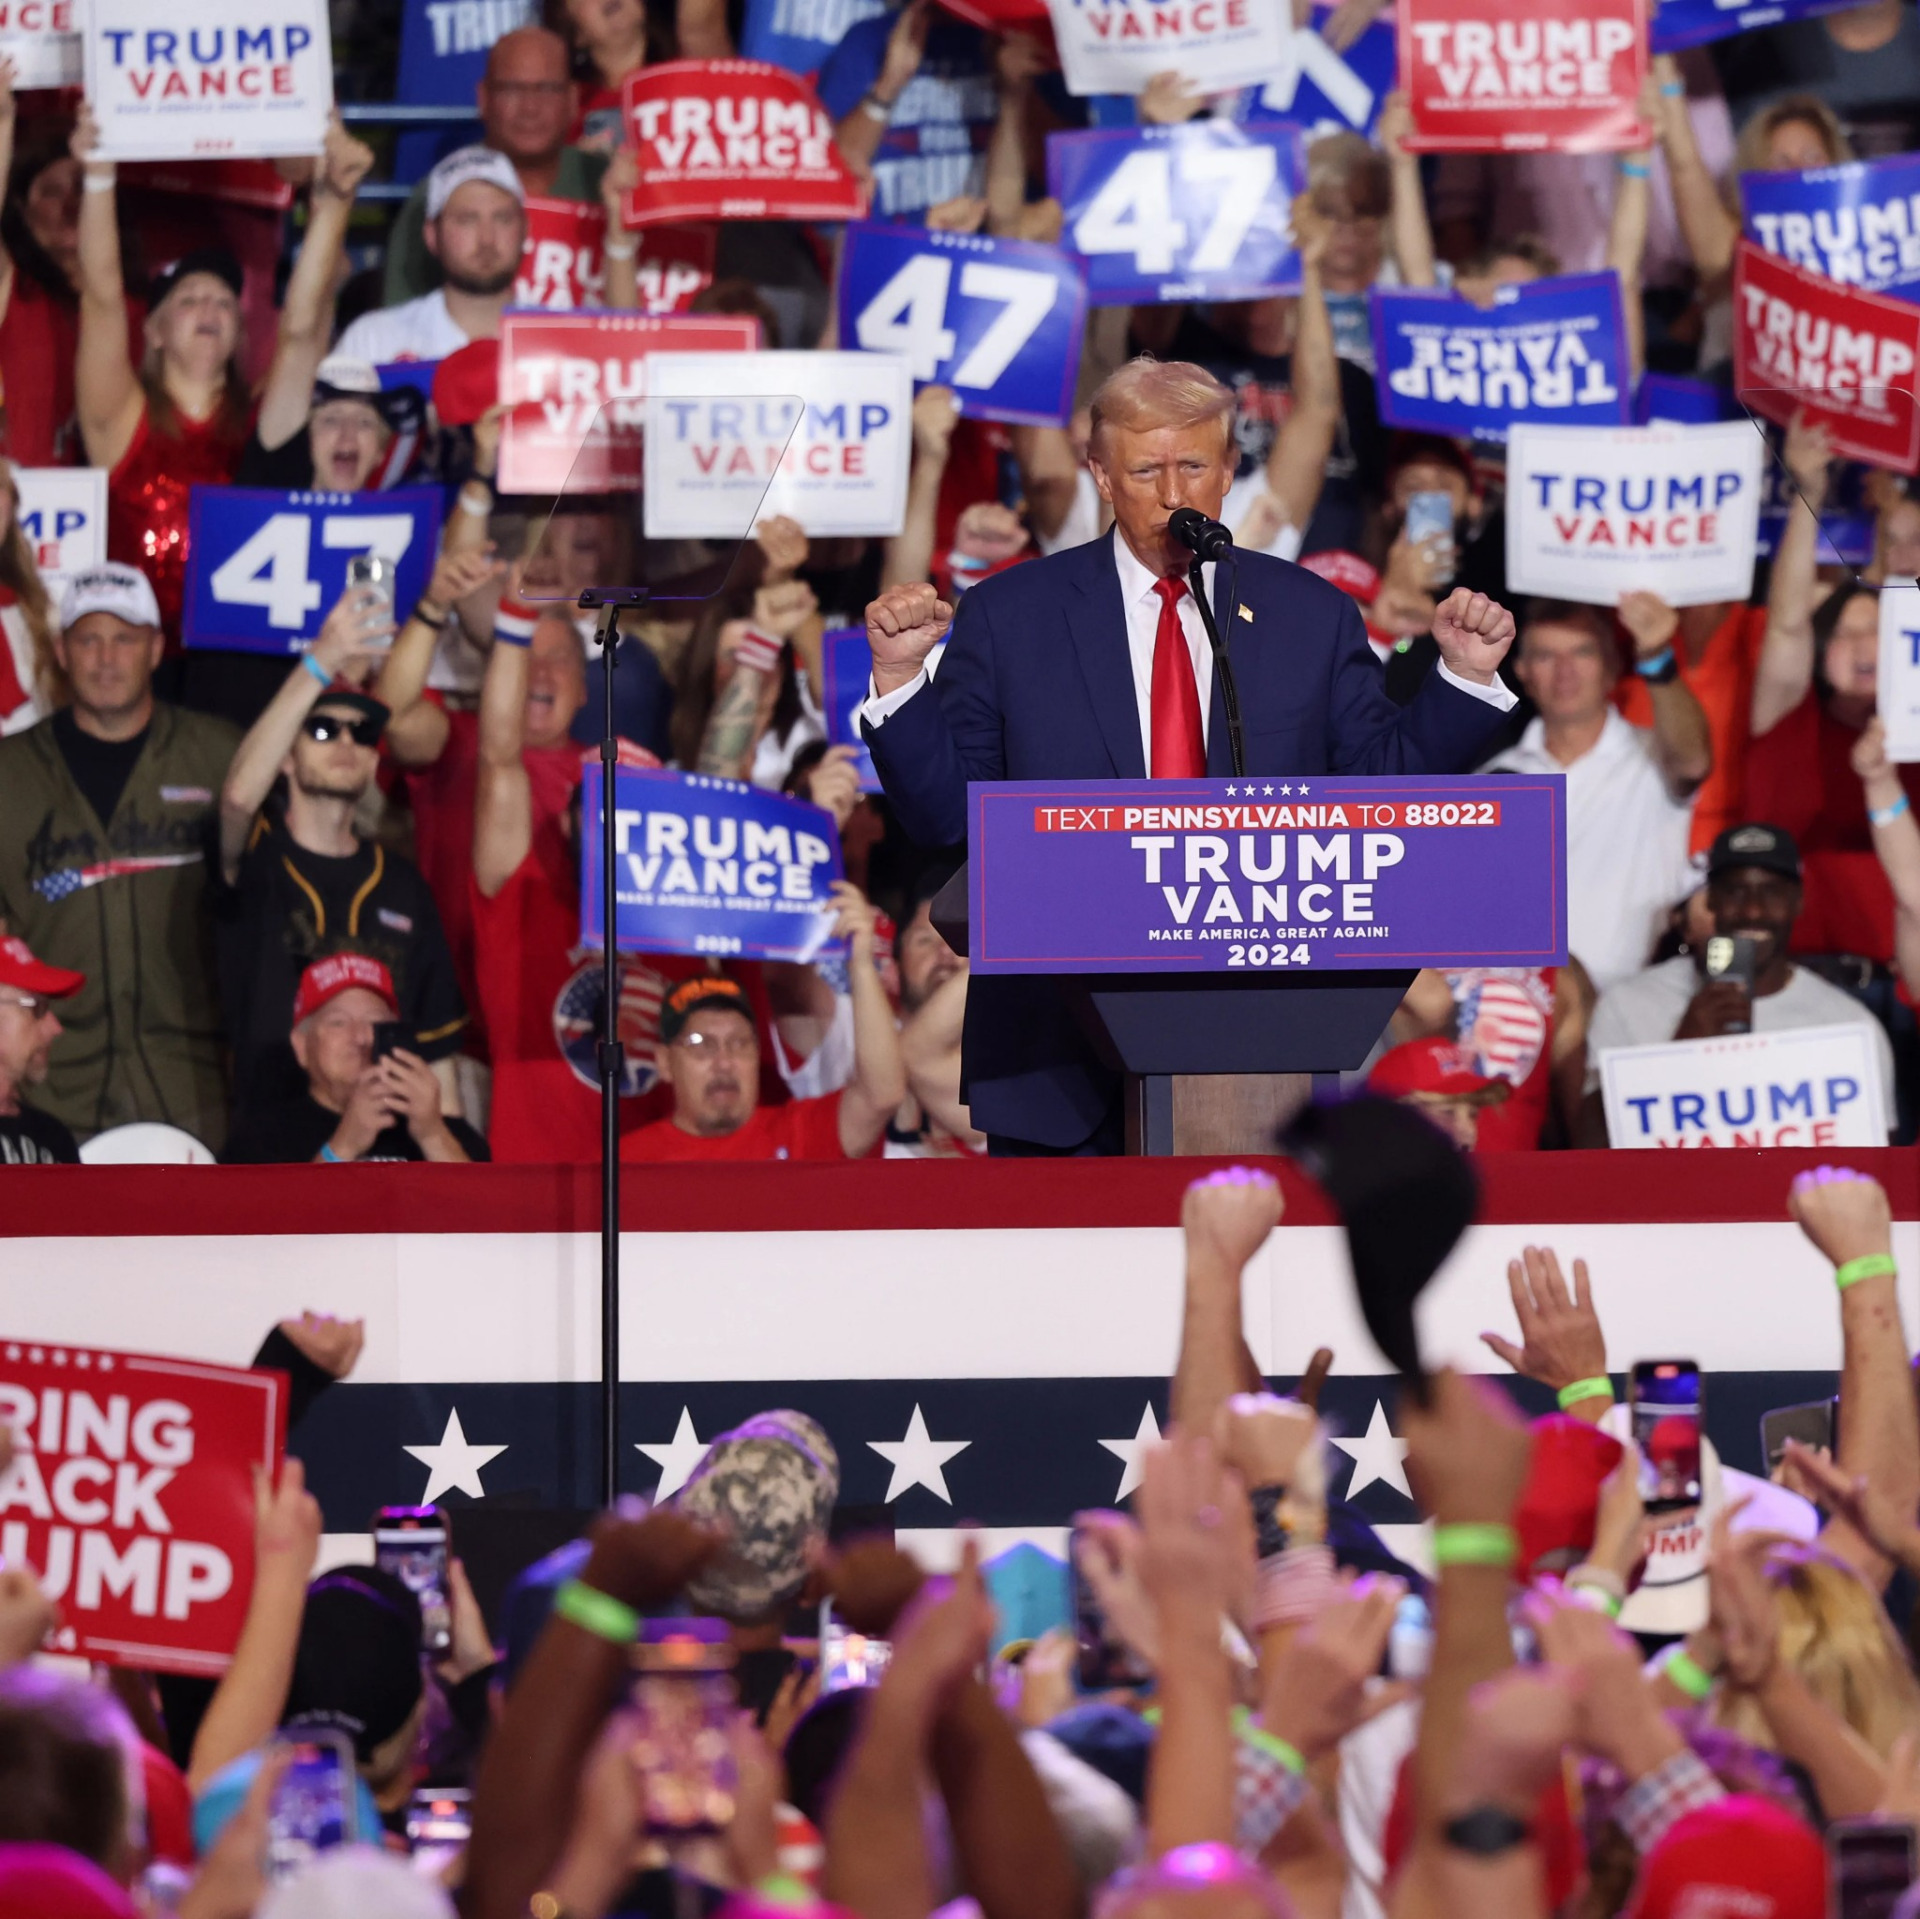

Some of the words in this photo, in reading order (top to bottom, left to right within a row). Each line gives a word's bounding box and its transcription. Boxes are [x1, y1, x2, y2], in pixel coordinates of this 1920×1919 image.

[1086, 0, 1248, 38] VANCE
[103, 26, 311, 67] TRUMP
[1413, 19, 1634, 65] TRUMP
[129, 65, 297, 98] VANCE
[1436, 59, 1611, 97] VANCE
[653, 134, 829, 169] VANCE
[1074, 146, 1277, 274] 47
[1752, 194, 1920, 264] TRUM
[856, 254, 1057, 391] 47
[1741, 284, 1914, 376] TRUMP
[1409, 331, 1590, 374] VANCE
[1754, 331, 1888, 409] VANCE
[517, 357, 643, 402] TRU
[1389, 361, 1618, 409] TRUMP
[664, 402, 890, 441] TRUMP
[692, 445, 865, 476] VANCE
[1530, 473, 1743, 513] TRUMP
[1553, 513, 1718, 546] VANCE
[210, 513, 414, 629] 47
[1041, 808, 1115, 830] TEXT
[1124, 805, 1350, 829] PENNSYLVANIA
[1357, 804, 1396, 827] TO
[1405, 803, 1495, 826] 88022
[600, 810, 831, 867] TRUMP
[1131, 833, 1406, 884] TRUMP
[627, 853, 814, 900] VANCE
[657, 892, 722, 909] AMERICA
[1161, 883, 1374, 924] VANCE
[695, 935, 742, 953] 2024
[1148, 929, 1194, 941] MAKE
[1198, 928, 1271, 940] AMERICA
[1276, 927, 1328, 939] GREAT
[1333, 926, 1390, 938] AGAIN!
[1227, 943, 1311, 967] 2024
[1626, 1077, 1859, 1135] TRUMP
